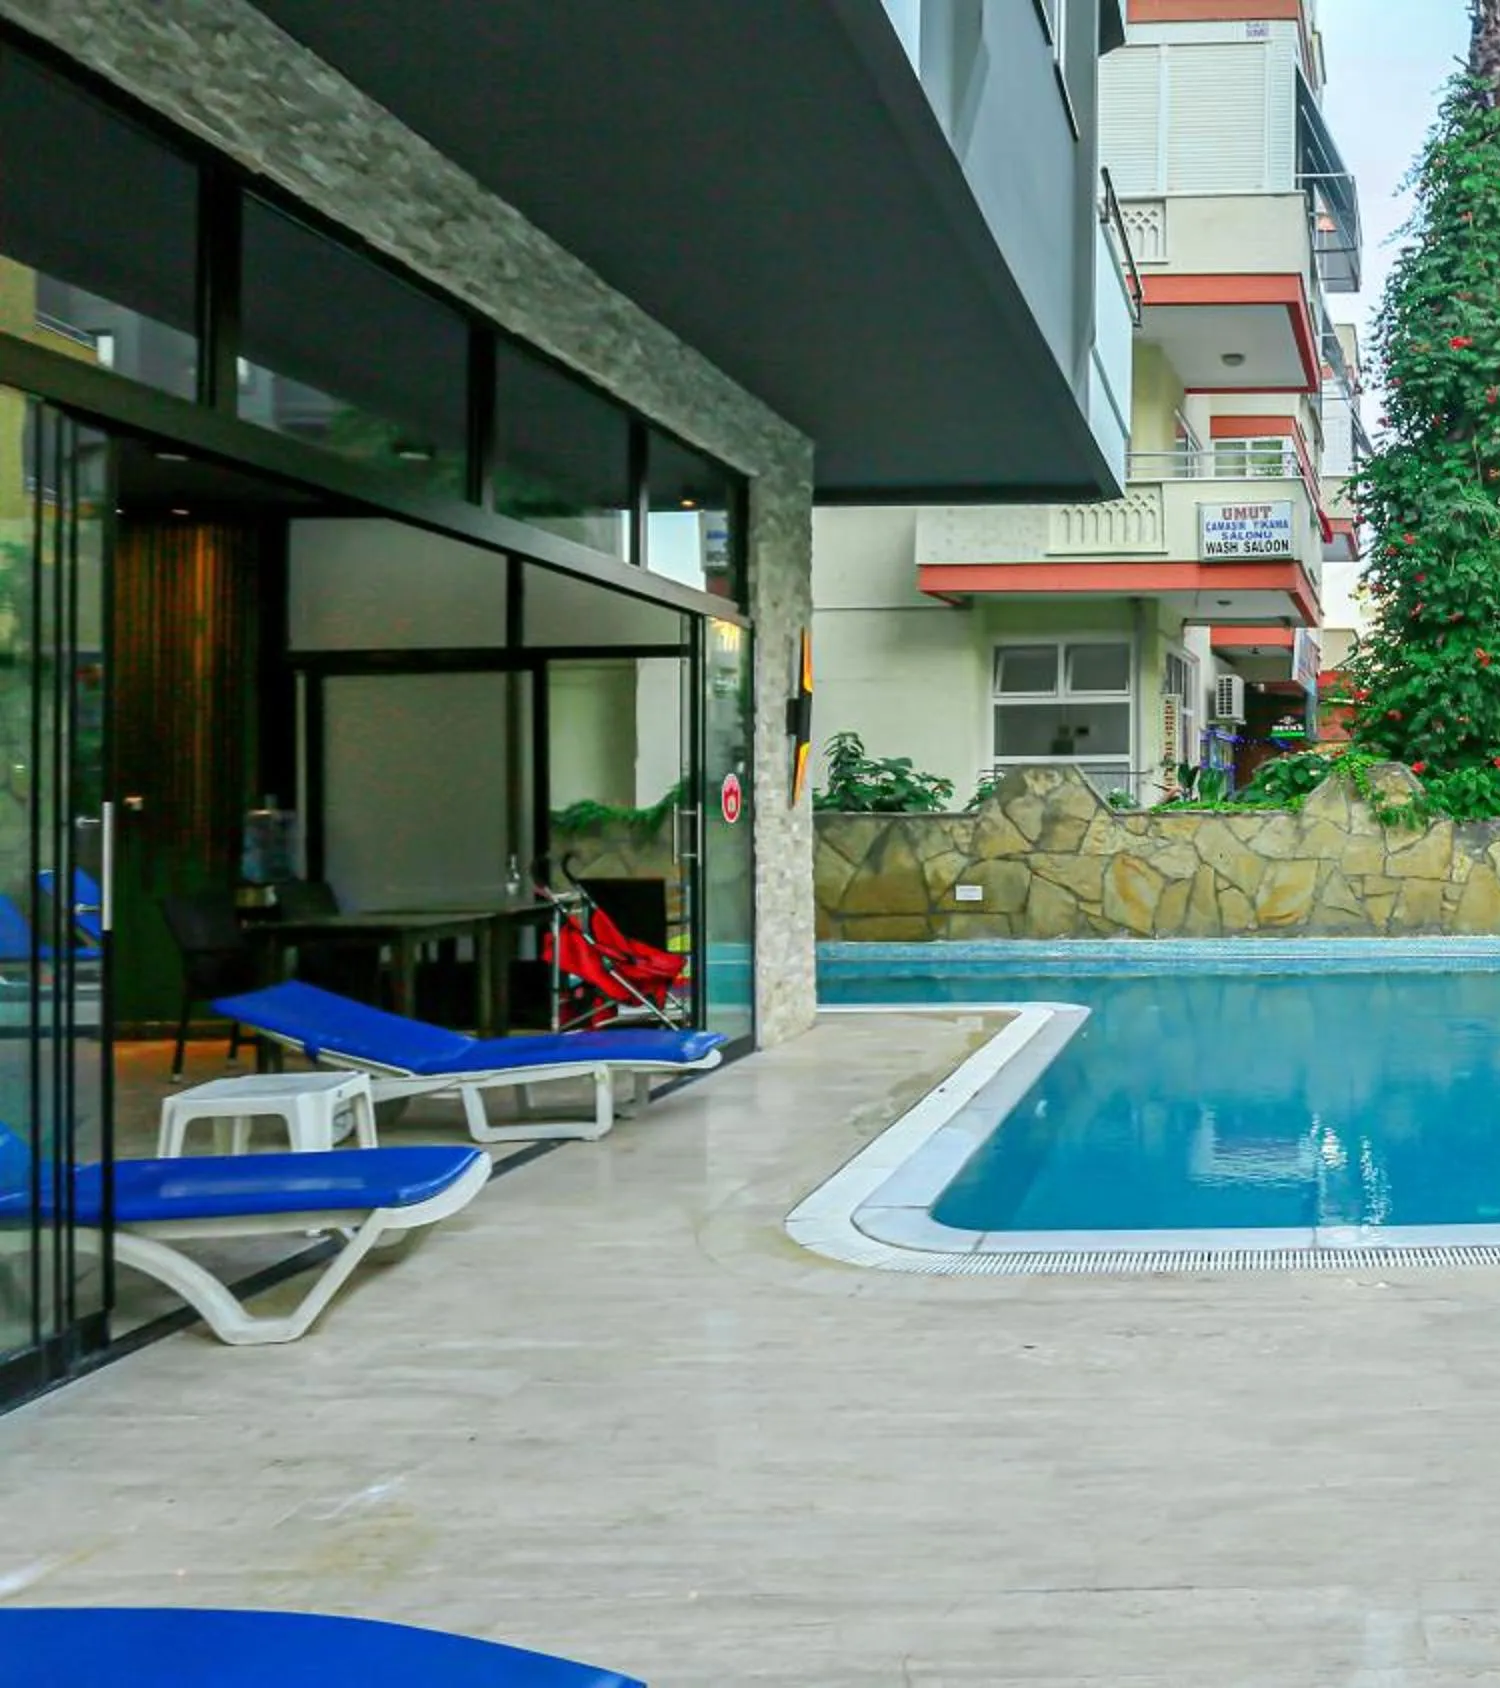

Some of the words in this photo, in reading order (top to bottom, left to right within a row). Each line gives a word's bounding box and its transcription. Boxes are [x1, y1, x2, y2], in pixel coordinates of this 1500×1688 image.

[1222, 506, 1271, 520] UMUT
[1221, 531, 1272, 540] SALONU
[1206, 541, 1238, 554] WASH
[1244, 540, 1289, 553] SALOON
